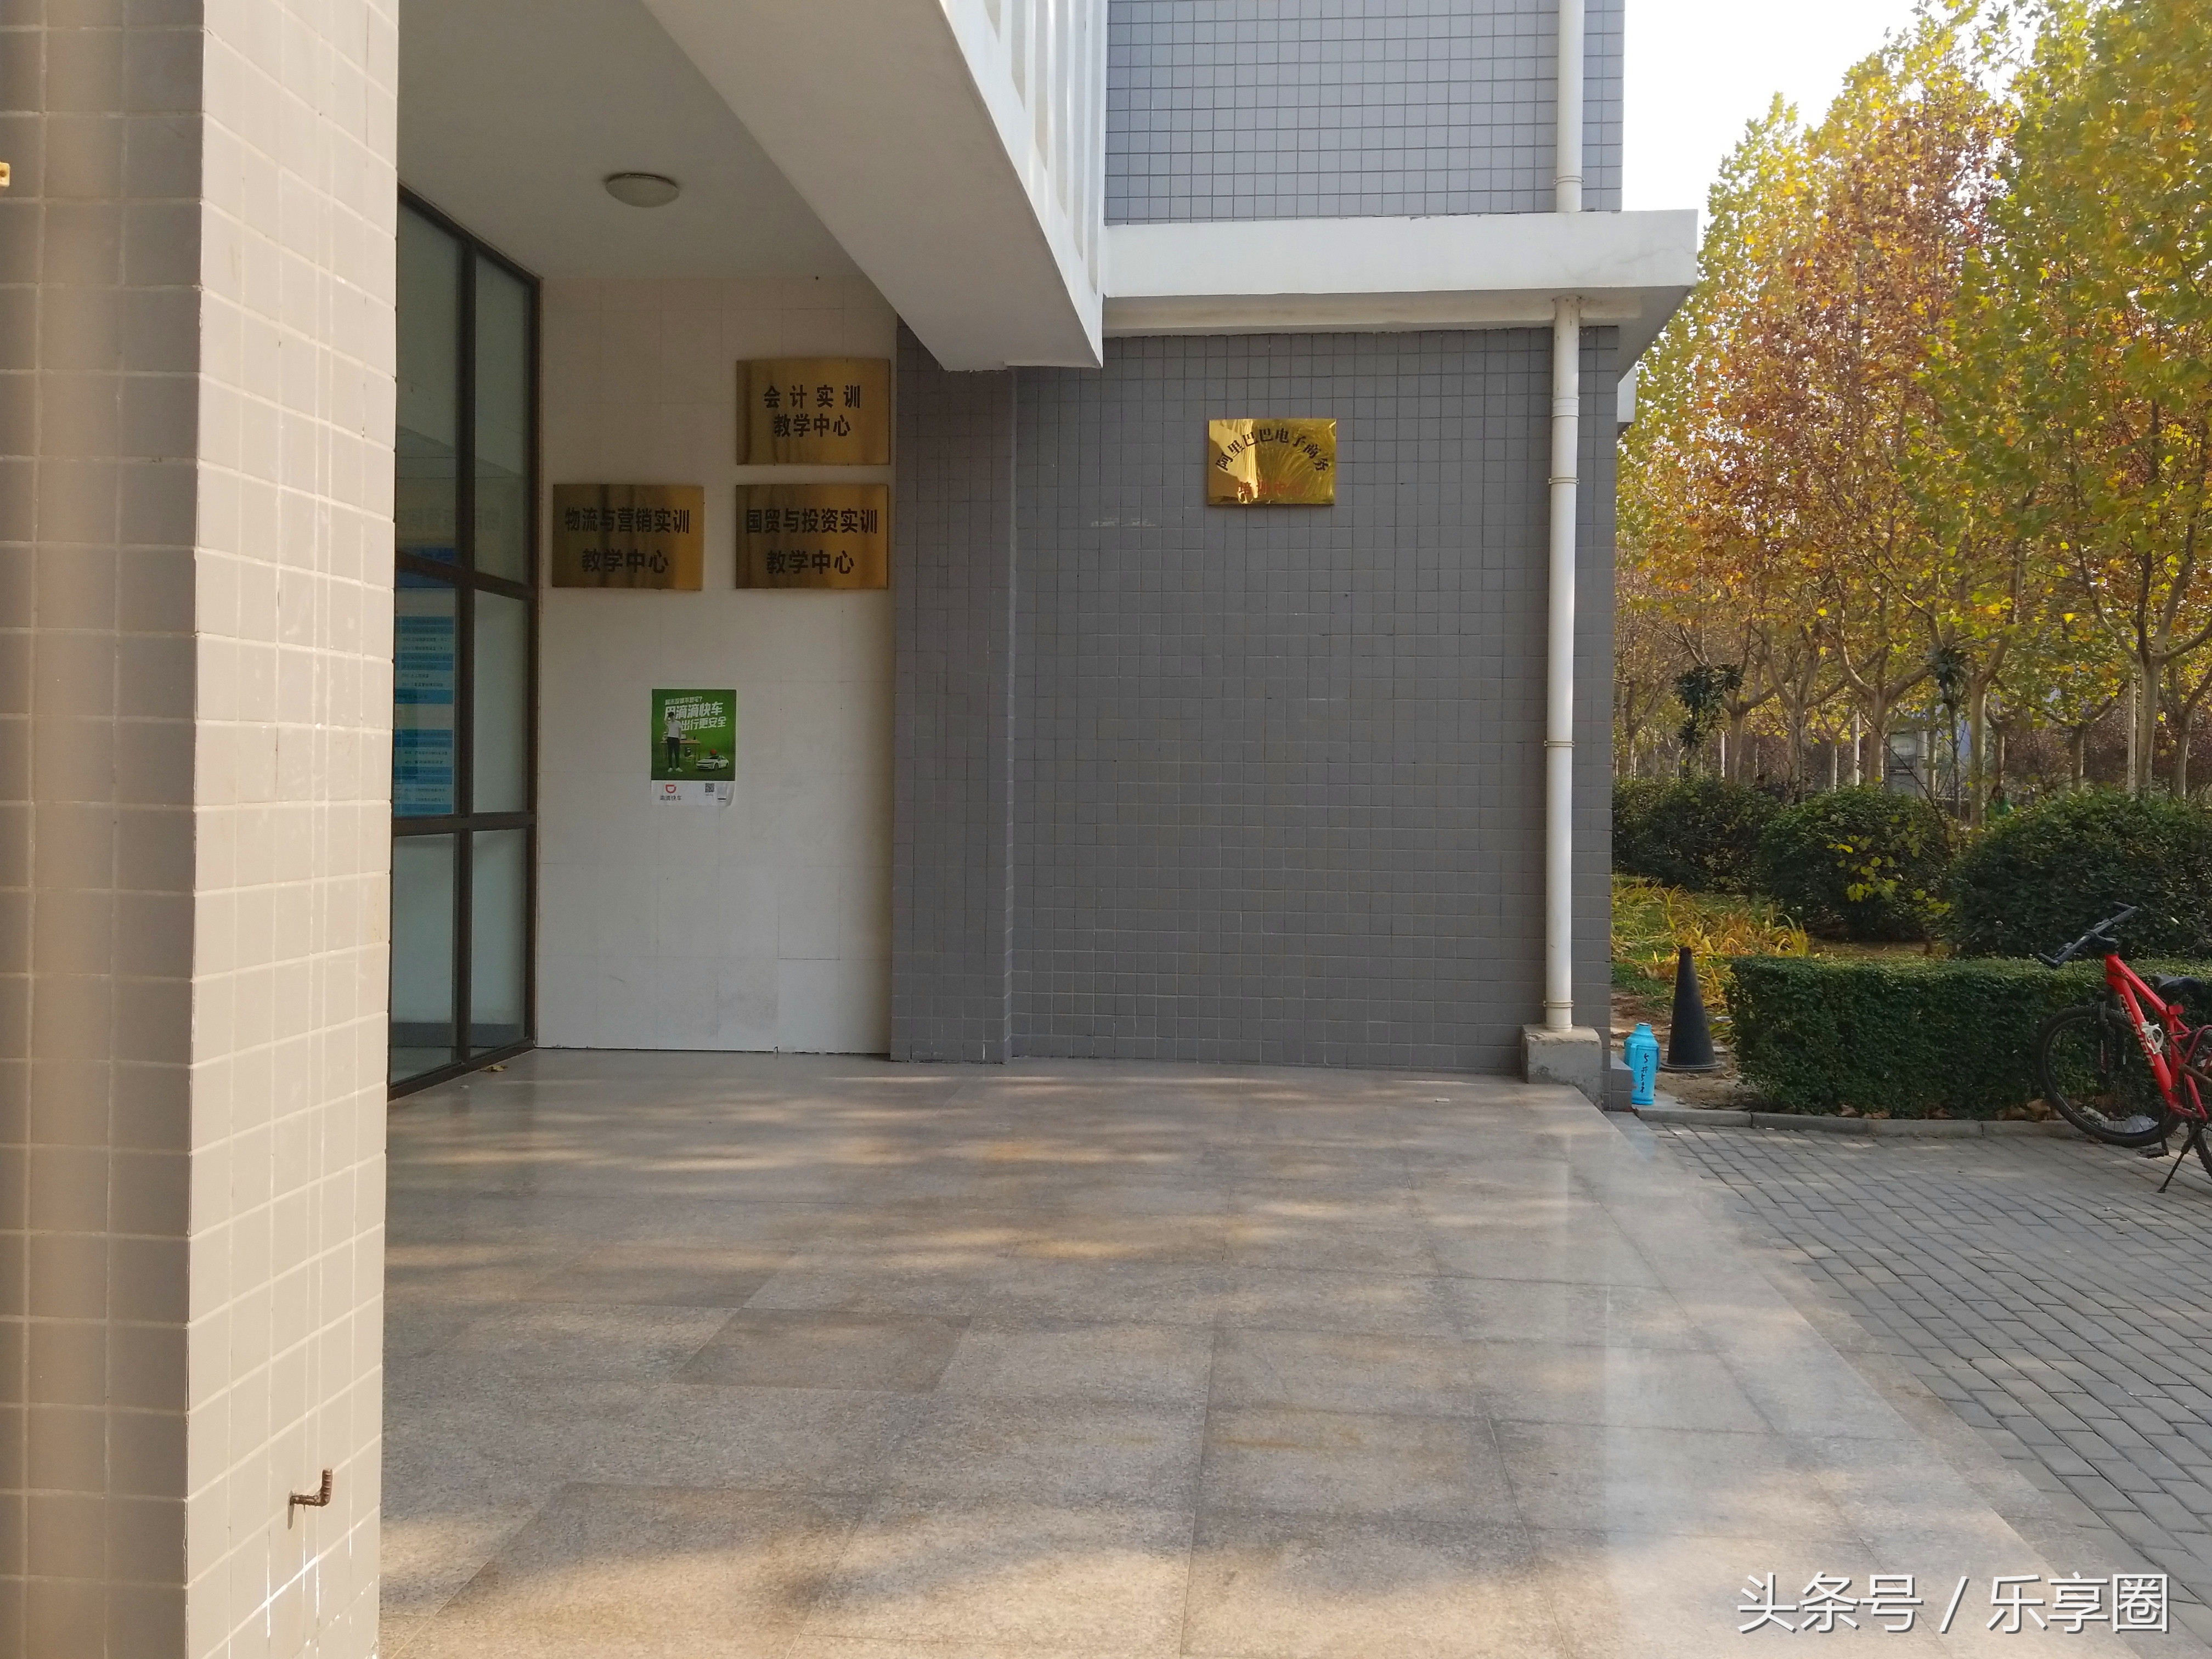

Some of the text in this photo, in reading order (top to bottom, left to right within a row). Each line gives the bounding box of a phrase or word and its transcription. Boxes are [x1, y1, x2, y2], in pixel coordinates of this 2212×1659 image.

[763, 385, 861, 409] 会计实训
[773, 413, 851, 438] 教学中心
[1215, 427, 1330, 472] 阿里巴巴电子商务
[565, 506, 690, 534] 物流与营销实训
[745, 507, 878, 534] 国贸与投资实训
[581, 549, 669, 574] 教学中心
[766, 549, 855, 575] 教学中心
[681, 716, 727, 731] 出行更安全
